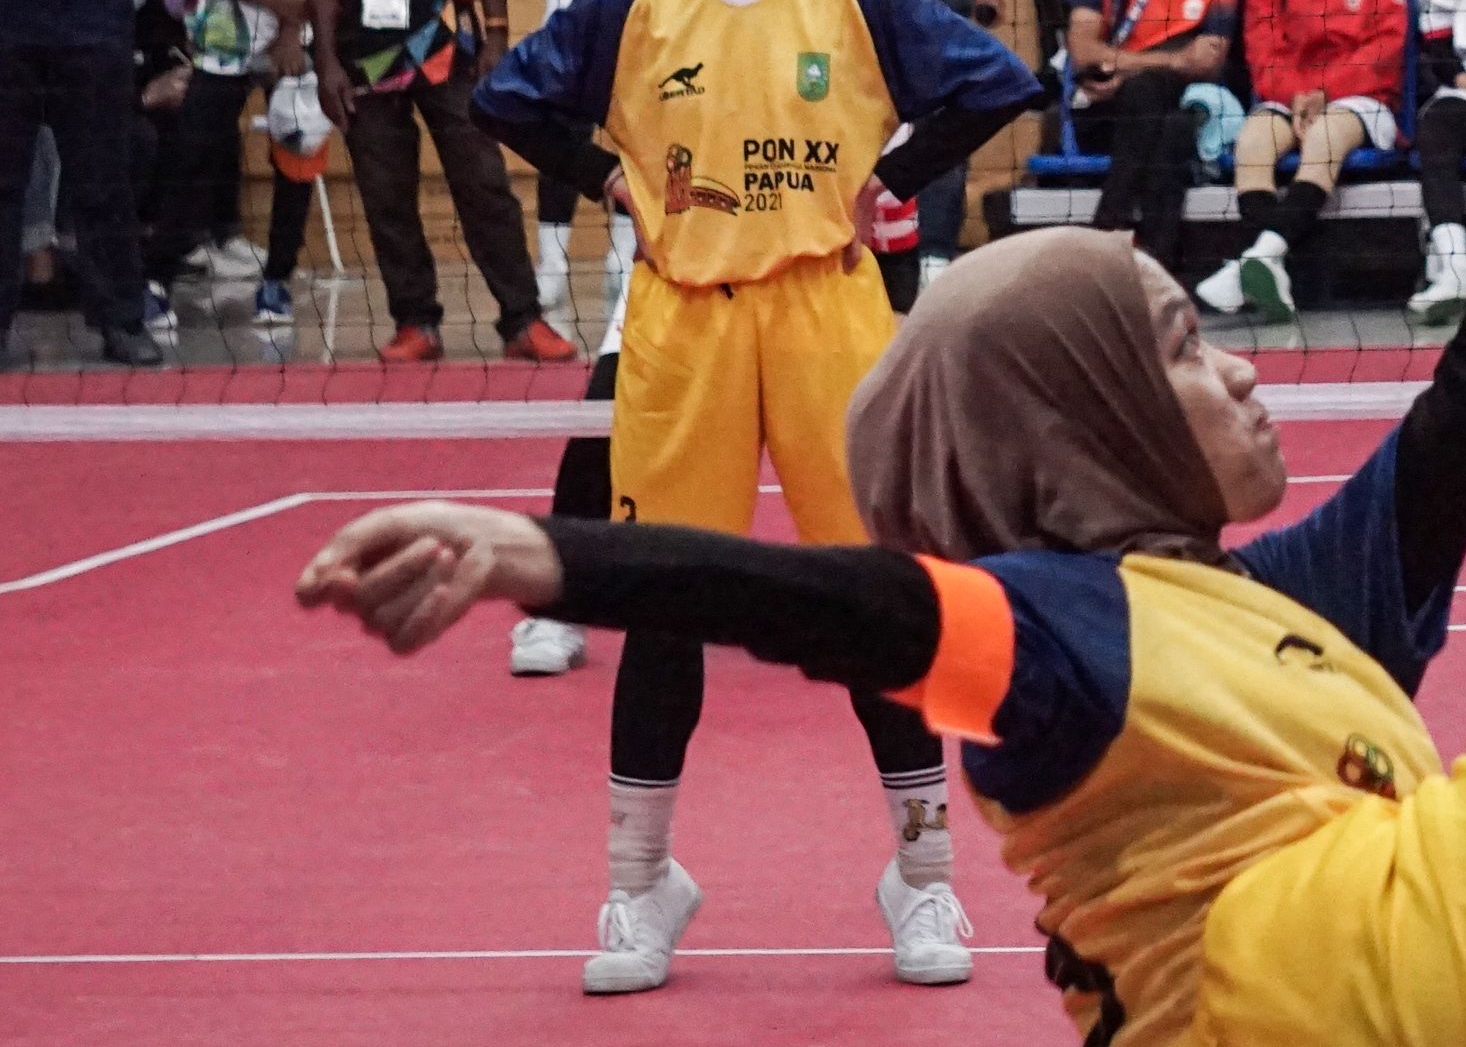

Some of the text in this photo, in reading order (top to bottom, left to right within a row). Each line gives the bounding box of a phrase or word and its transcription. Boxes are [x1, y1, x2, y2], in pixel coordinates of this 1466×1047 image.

[743, 138, 839, 164] PON XX
[744, 171, 815, 192] PAPUA
[744, 192, 783, 211] 2021
